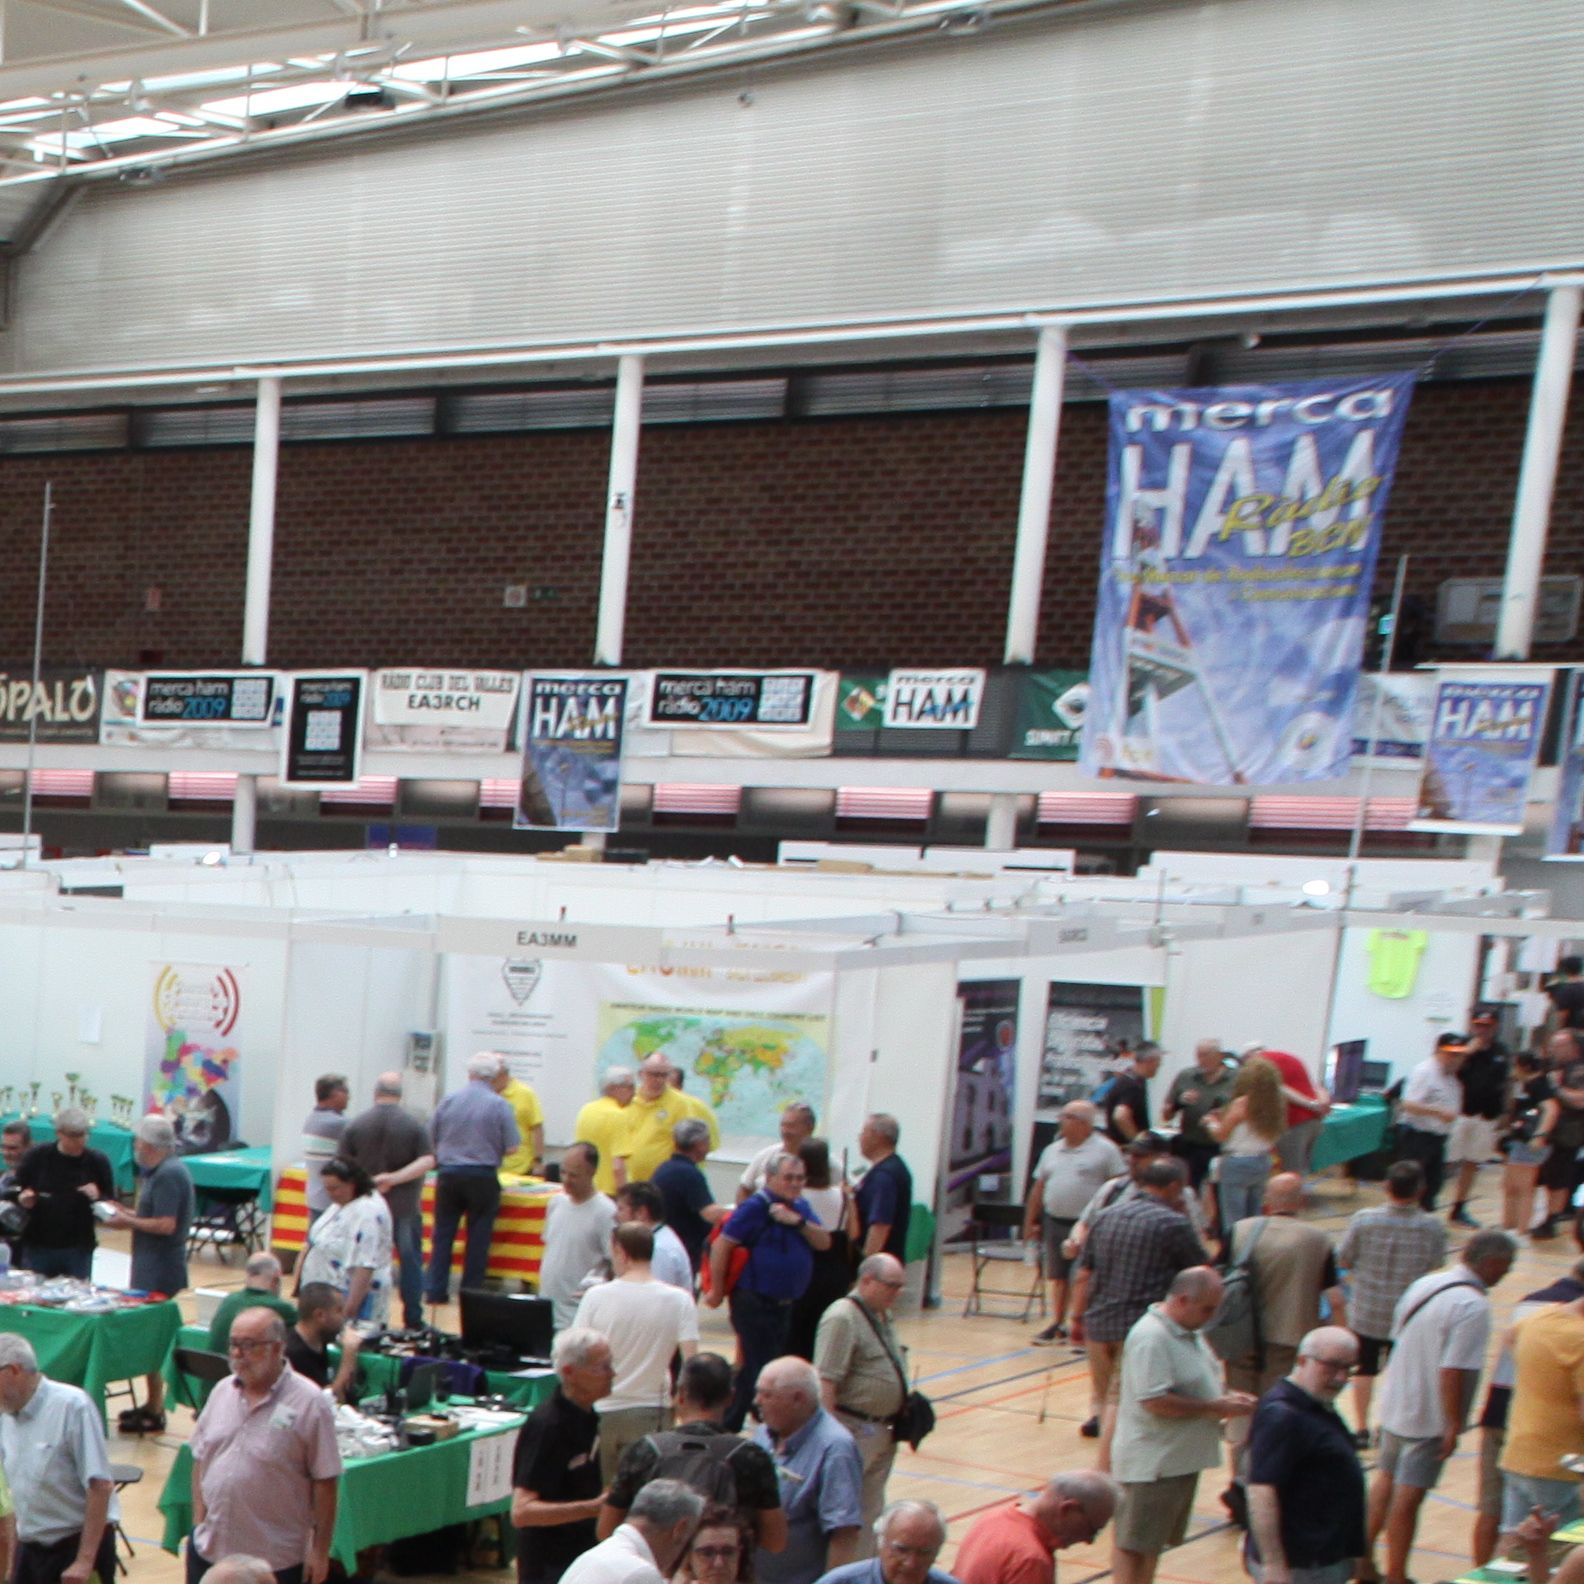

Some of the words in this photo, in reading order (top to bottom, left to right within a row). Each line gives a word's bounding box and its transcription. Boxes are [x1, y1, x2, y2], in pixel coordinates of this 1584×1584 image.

[1125, 387, 1395, 434] merca
[1111, 427, 1377, 560] HAM
[1218, 475, 1383, 543] Radio
[535, 681, 623, 696] merca
[658, 678, 713, 697] merca
[714, 676, 757, 696] ham
[895, 674, 977, 686] merca
[182, 699, 226, 719] 2009
[407, 694, 481, 712] EA3RCH
[697, 697, 754, 722] 2009
[892, 687, 976, 722] HAM
[532, 696, 618, 740] HAM
[1435, 699, 1535, 741] HAM
[516, 931, 578, 948] EA3MM
